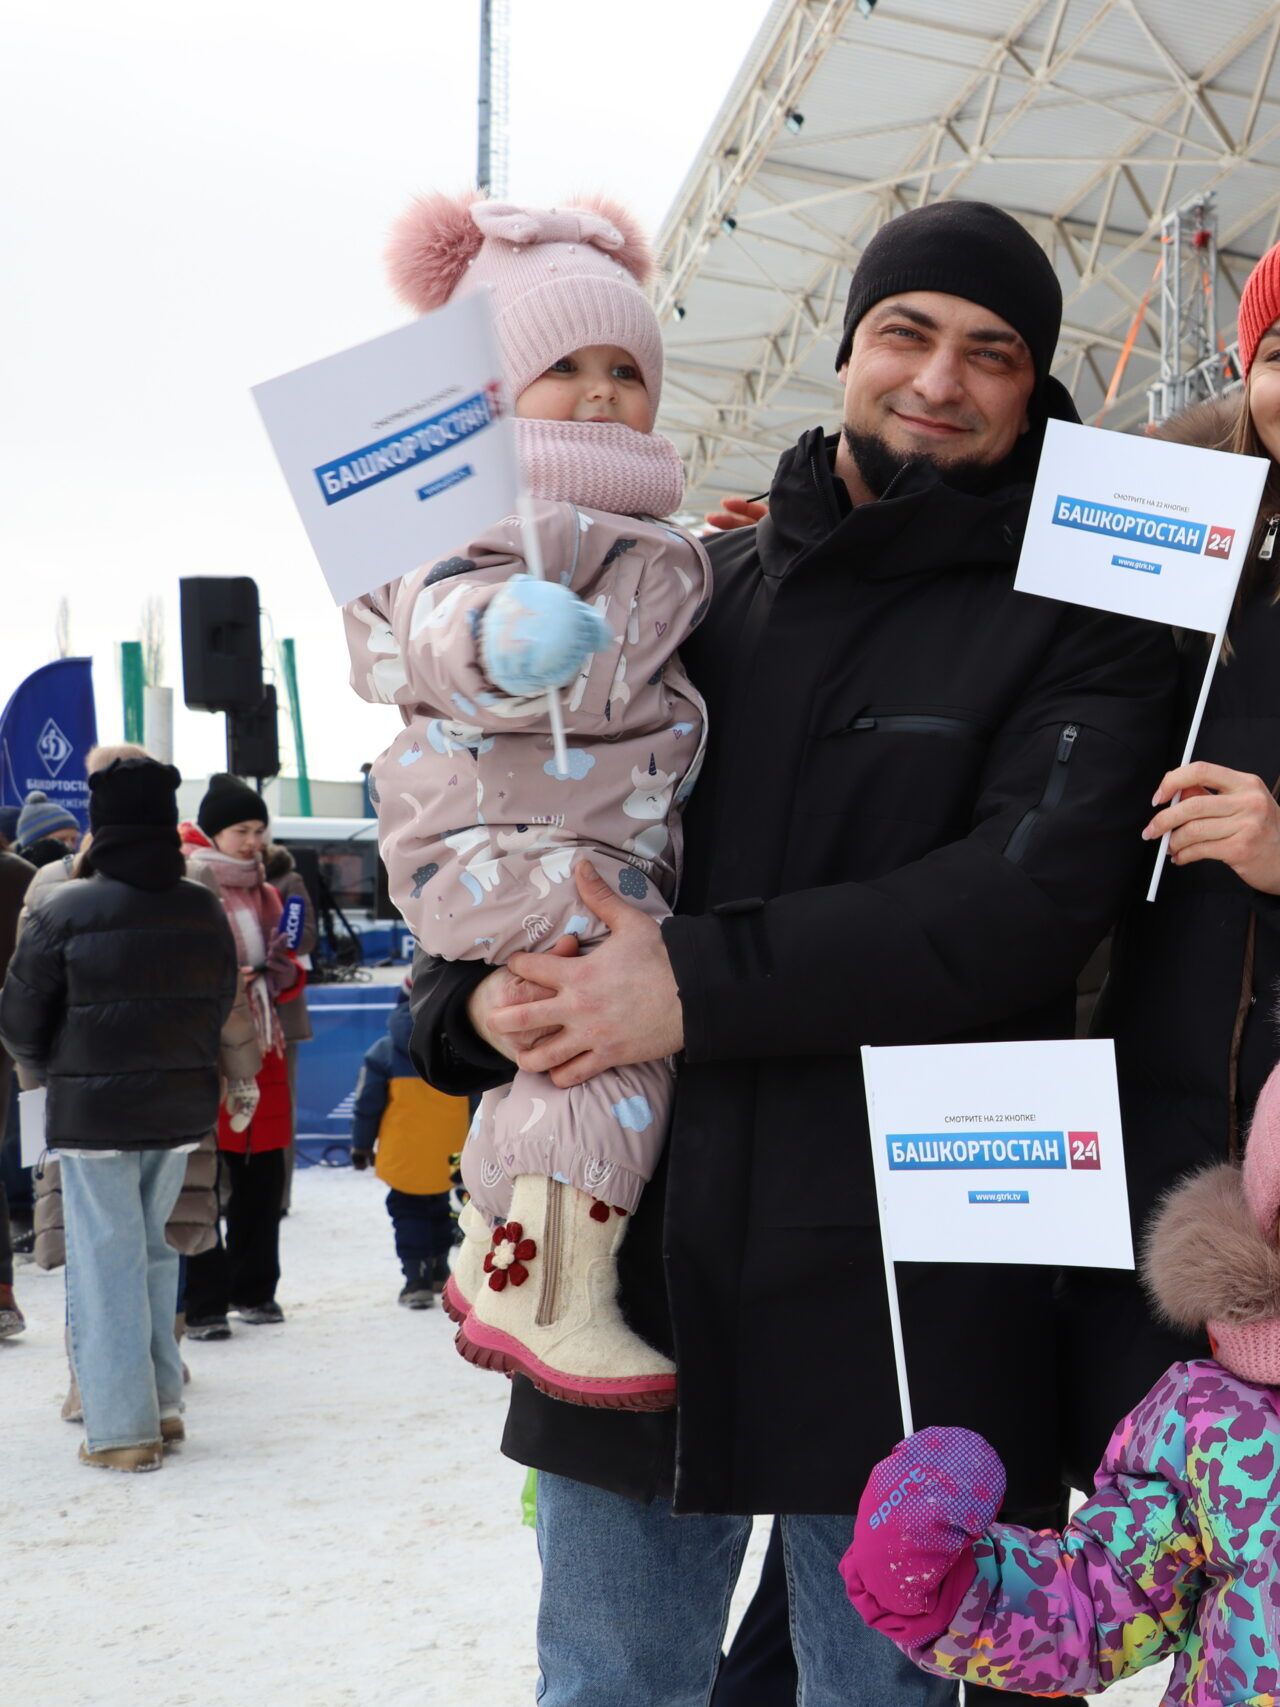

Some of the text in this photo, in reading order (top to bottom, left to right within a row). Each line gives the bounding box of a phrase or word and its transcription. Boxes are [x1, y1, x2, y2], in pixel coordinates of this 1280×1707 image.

[320, 399, 491, 496] БАШКОРТОСТАН
[1113, 492, 1146, 505] СМОТРИТЕ
[1155, 500, 1163, 508] 22
[1163, 502, 1190, 513] КНОПКЕ!
[1057, 501, 1232, 553] БАШКОРТОСТАН 24
[1117, 557, 1156, 572] www.gtrk.tv
[944, 1113, 1036, 1124] СМОТРИТЕ НА 22 КНОПКЕ!
[891, 1138, 1099, 1164] БАШКОРТОСТАН 24
[975, 1192, 1021, 1202] www.gtrk.tv
[868, 1465, 927, 1530] sport
